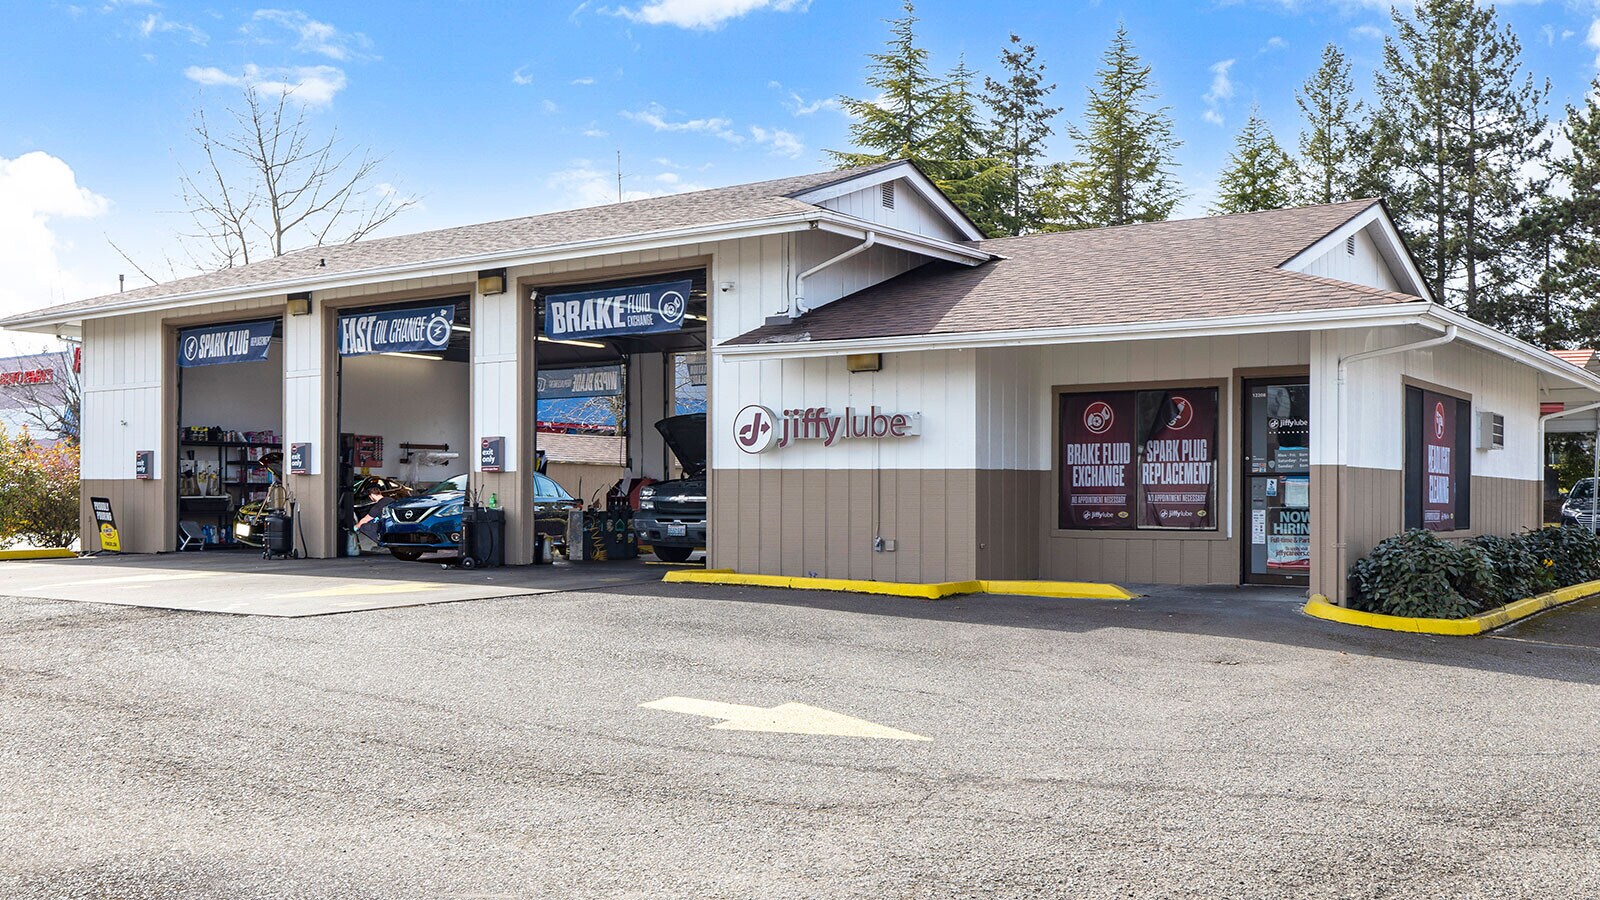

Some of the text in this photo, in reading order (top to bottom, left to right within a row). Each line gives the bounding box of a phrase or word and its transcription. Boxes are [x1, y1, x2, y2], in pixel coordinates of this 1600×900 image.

[627, 293, 651, 313] FLUID
[551, 295, 627, 334] BRAKE
[627, 313, 654, 327] EXCHANGE
[198, 332, 228, 359] SPARK
[227, 329, 250, 356] PLUG
[342, 315, 427, 354] FAST OIL CHANGE
[482, 448, 494, 456] exit
[482, 455, 496, 464] only
[1067, 442, 1131, 465] BRAKE FLUID
[1147, 439, 1207, 462] SPARK PLUG
[1072, 465, 1125, 487] EXCHANGE
[1142, 462, 1211, 485] REPLACEMENT
[1280, 511, 1310, 523] NOW
